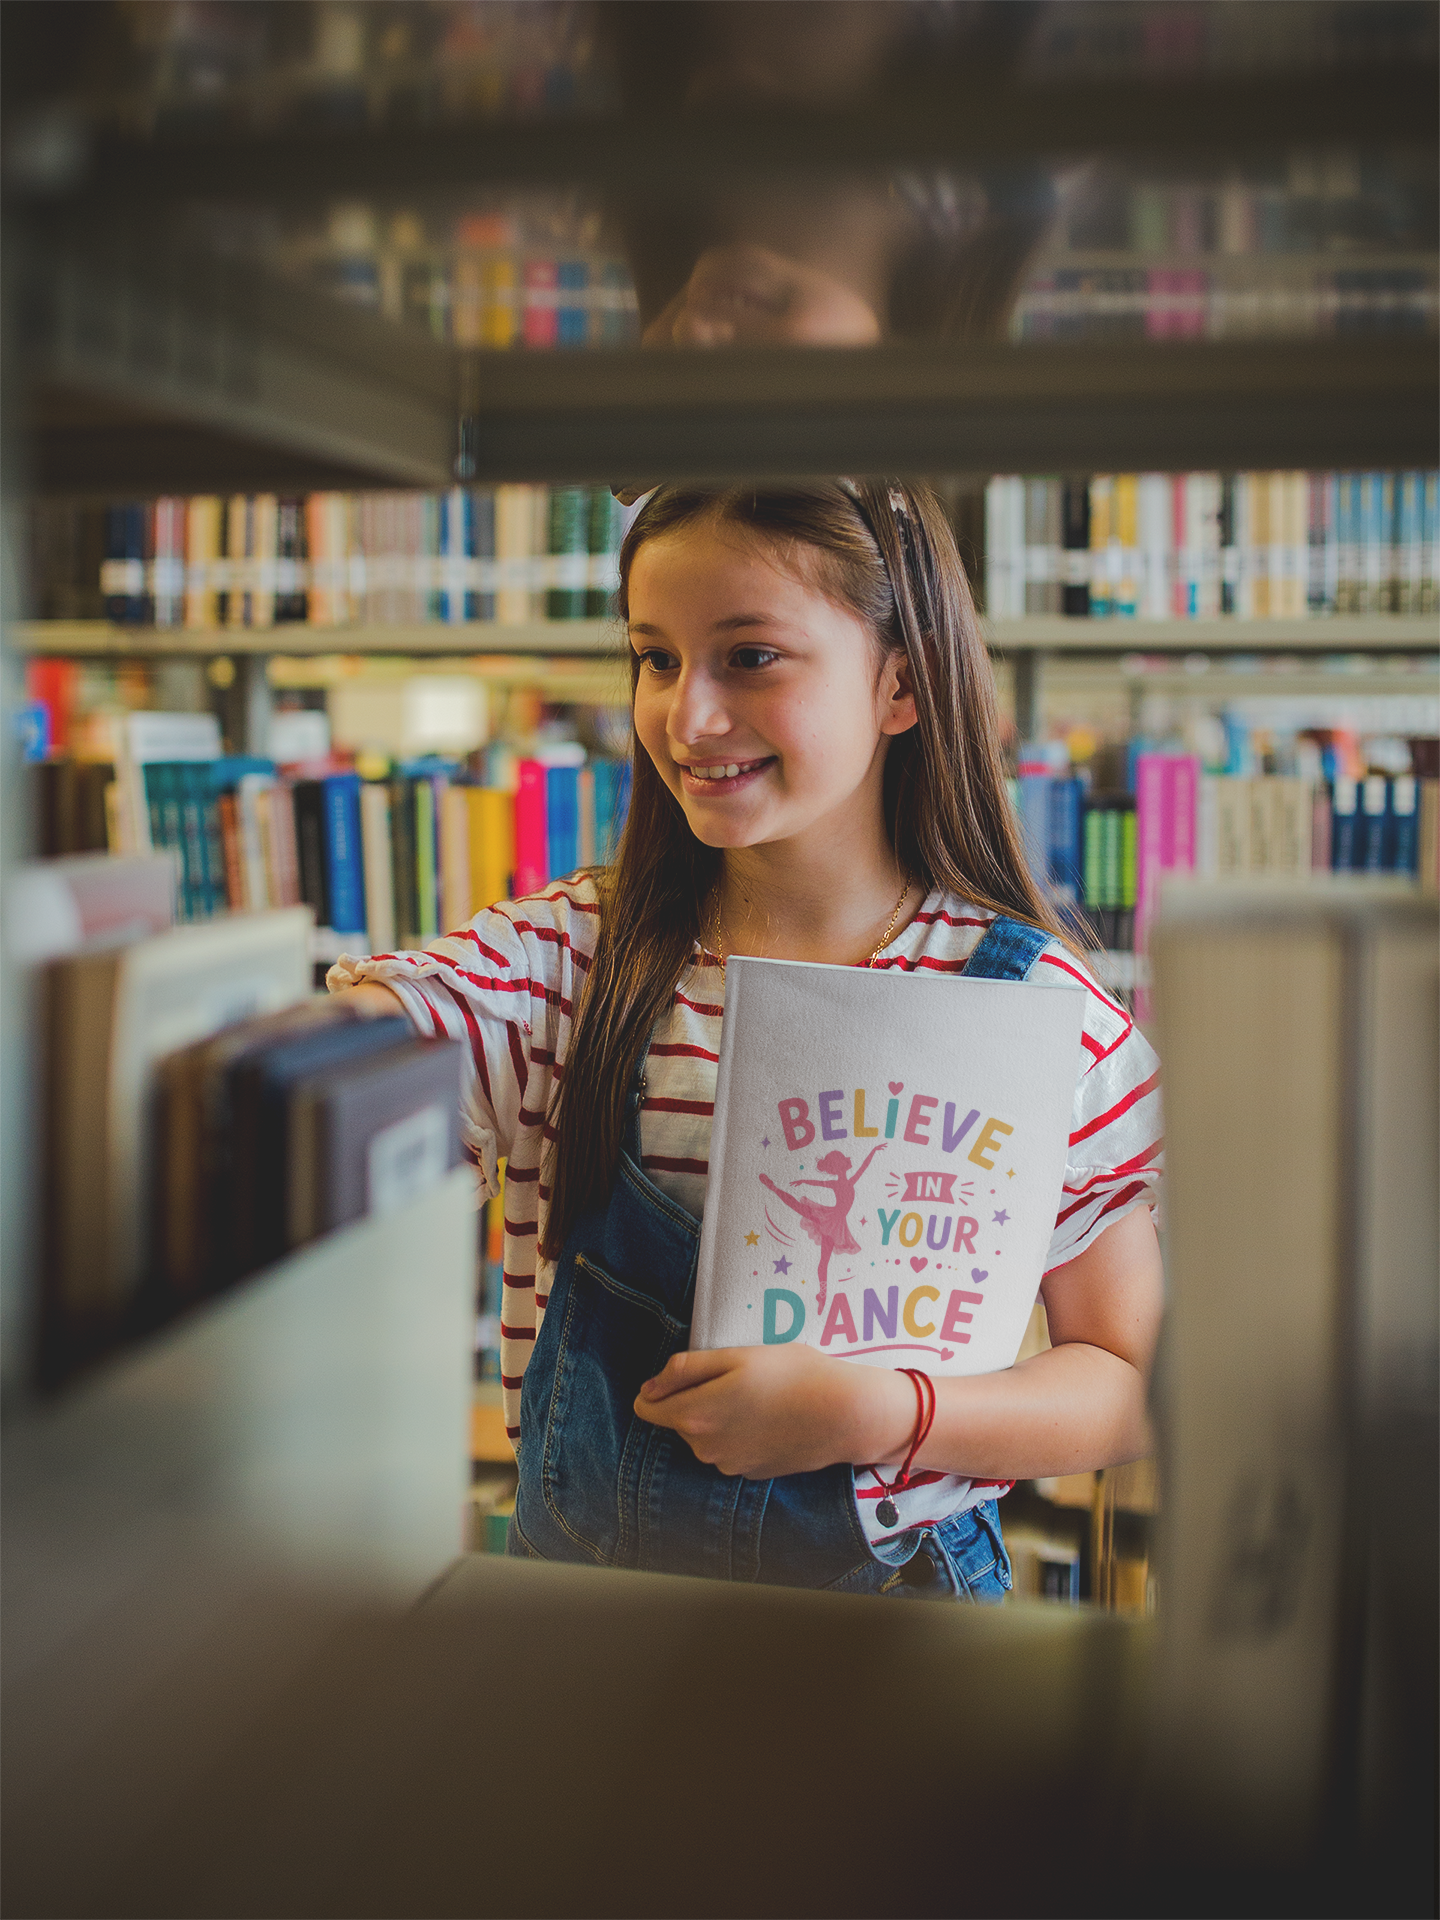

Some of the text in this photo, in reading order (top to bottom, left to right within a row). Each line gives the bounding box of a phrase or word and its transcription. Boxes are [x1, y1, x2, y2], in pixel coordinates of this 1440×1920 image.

[916, 1176, 942, 1198] IN
[878, 1208, 980, 1254] YOUR
[763, 1285, 984, 1346] DANCE
